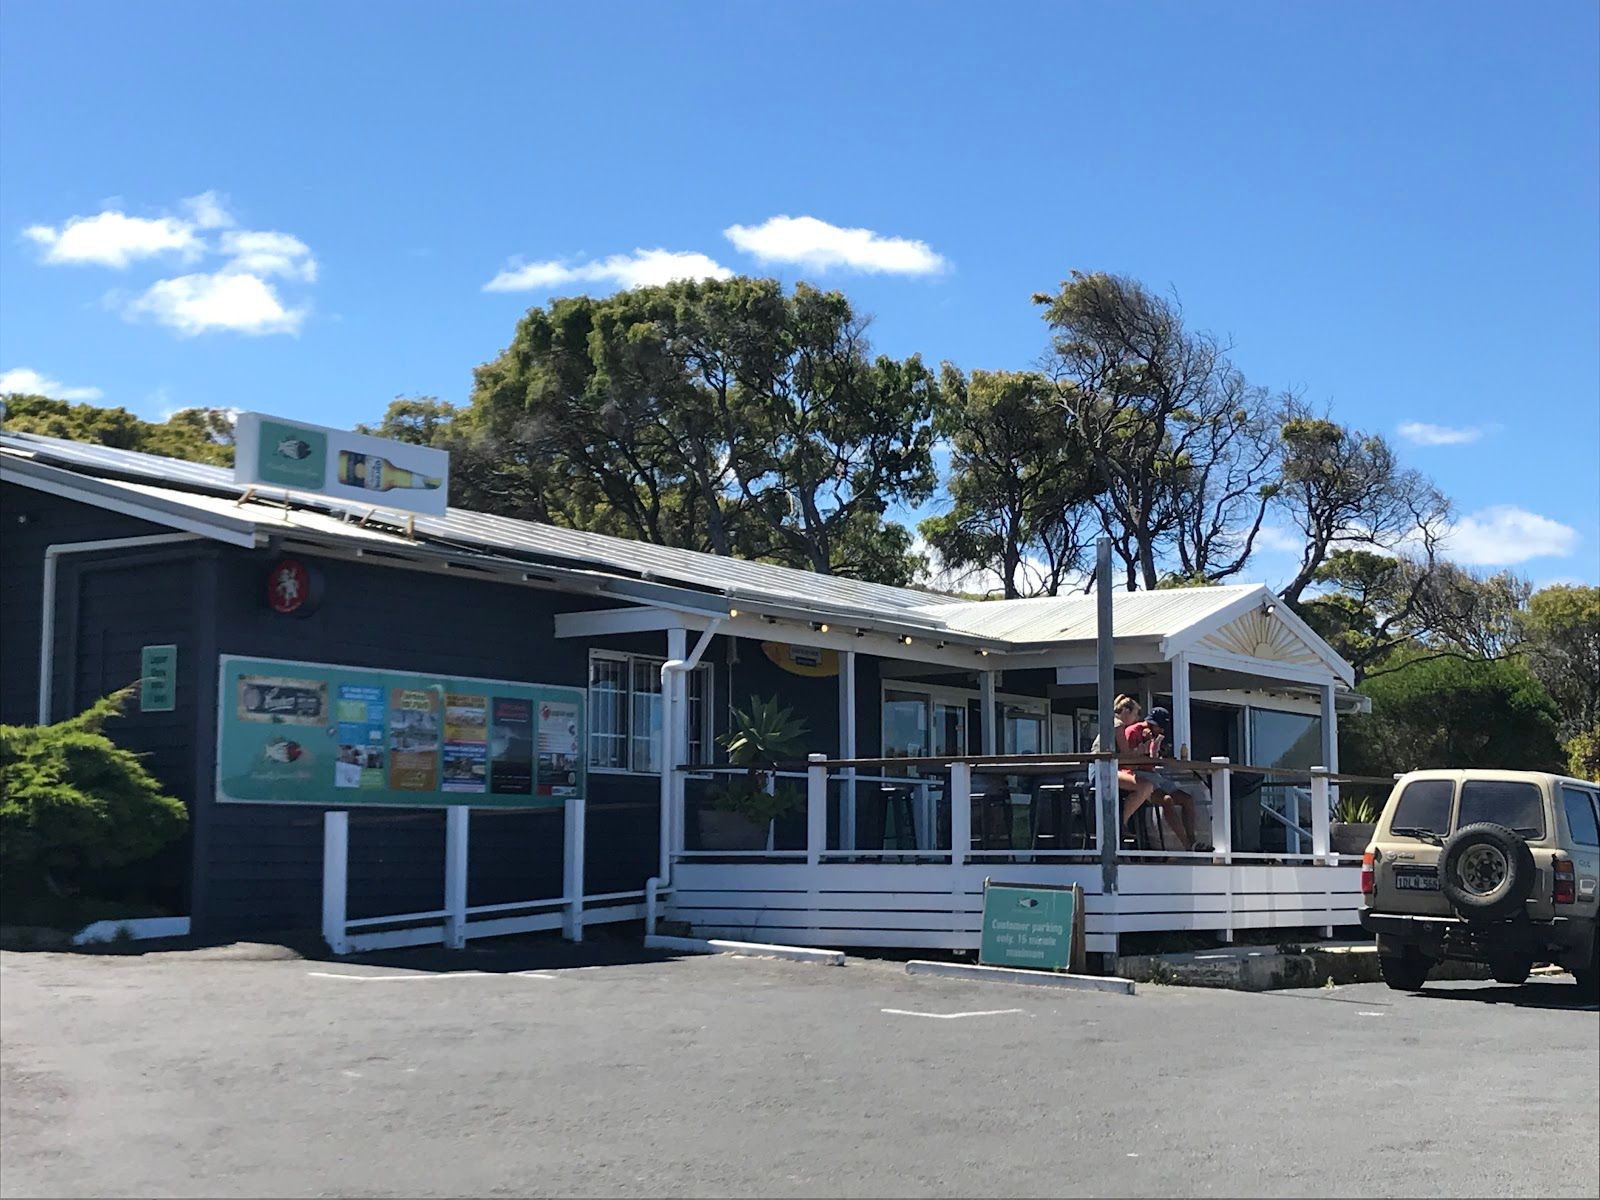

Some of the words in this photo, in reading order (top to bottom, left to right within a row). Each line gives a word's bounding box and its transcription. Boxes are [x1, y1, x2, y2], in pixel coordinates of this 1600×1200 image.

[991, 919, 1030, 930] Customer
[1032, 922, 1063, 935] parking
[1018, 933, 1028, 945] 15
